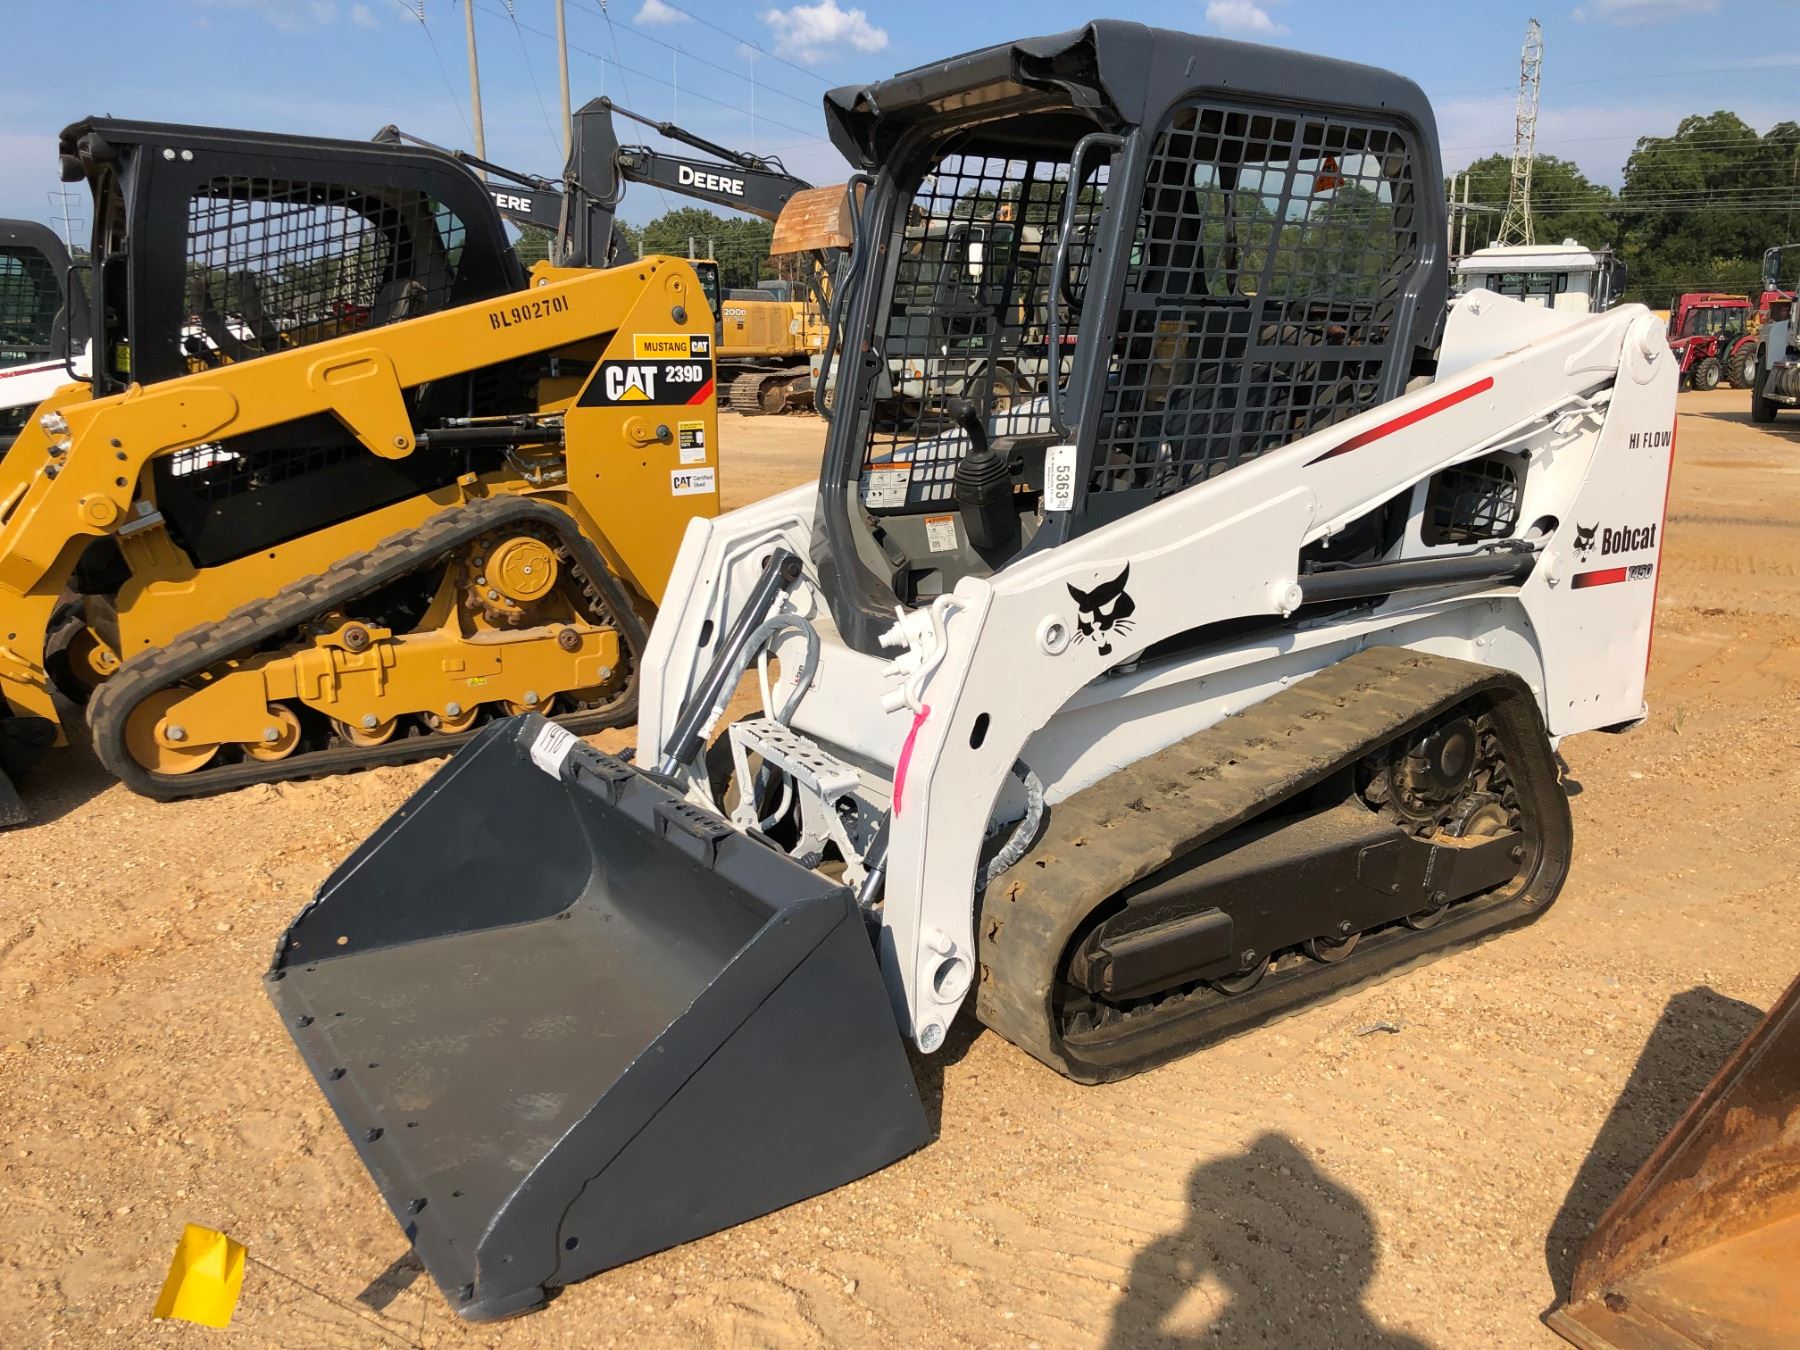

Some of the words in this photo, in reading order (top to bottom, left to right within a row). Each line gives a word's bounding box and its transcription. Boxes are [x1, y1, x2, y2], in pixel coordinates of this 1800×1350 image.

[679, 165, 744, 196] DEERE
[490, 192, 531, 212] ERE
[489, 295, 569, 330] BL902701
[724, 308, 746, 316] 200D
[644, 342, 687, 352] MUSTANG
[691, 341, 708, 353] CAT
[605, 366, 658, 401] CAT
[665, 365, 703, 383] 239D
[1629, 433, 1640, 449] HI
[1643, 431, 1672, 448] FLOW
[673, 476, 692, 489] CAT
[1055, 465, 1070, 499] 5363
[1601, 523, 1656, 556] Bobcat
